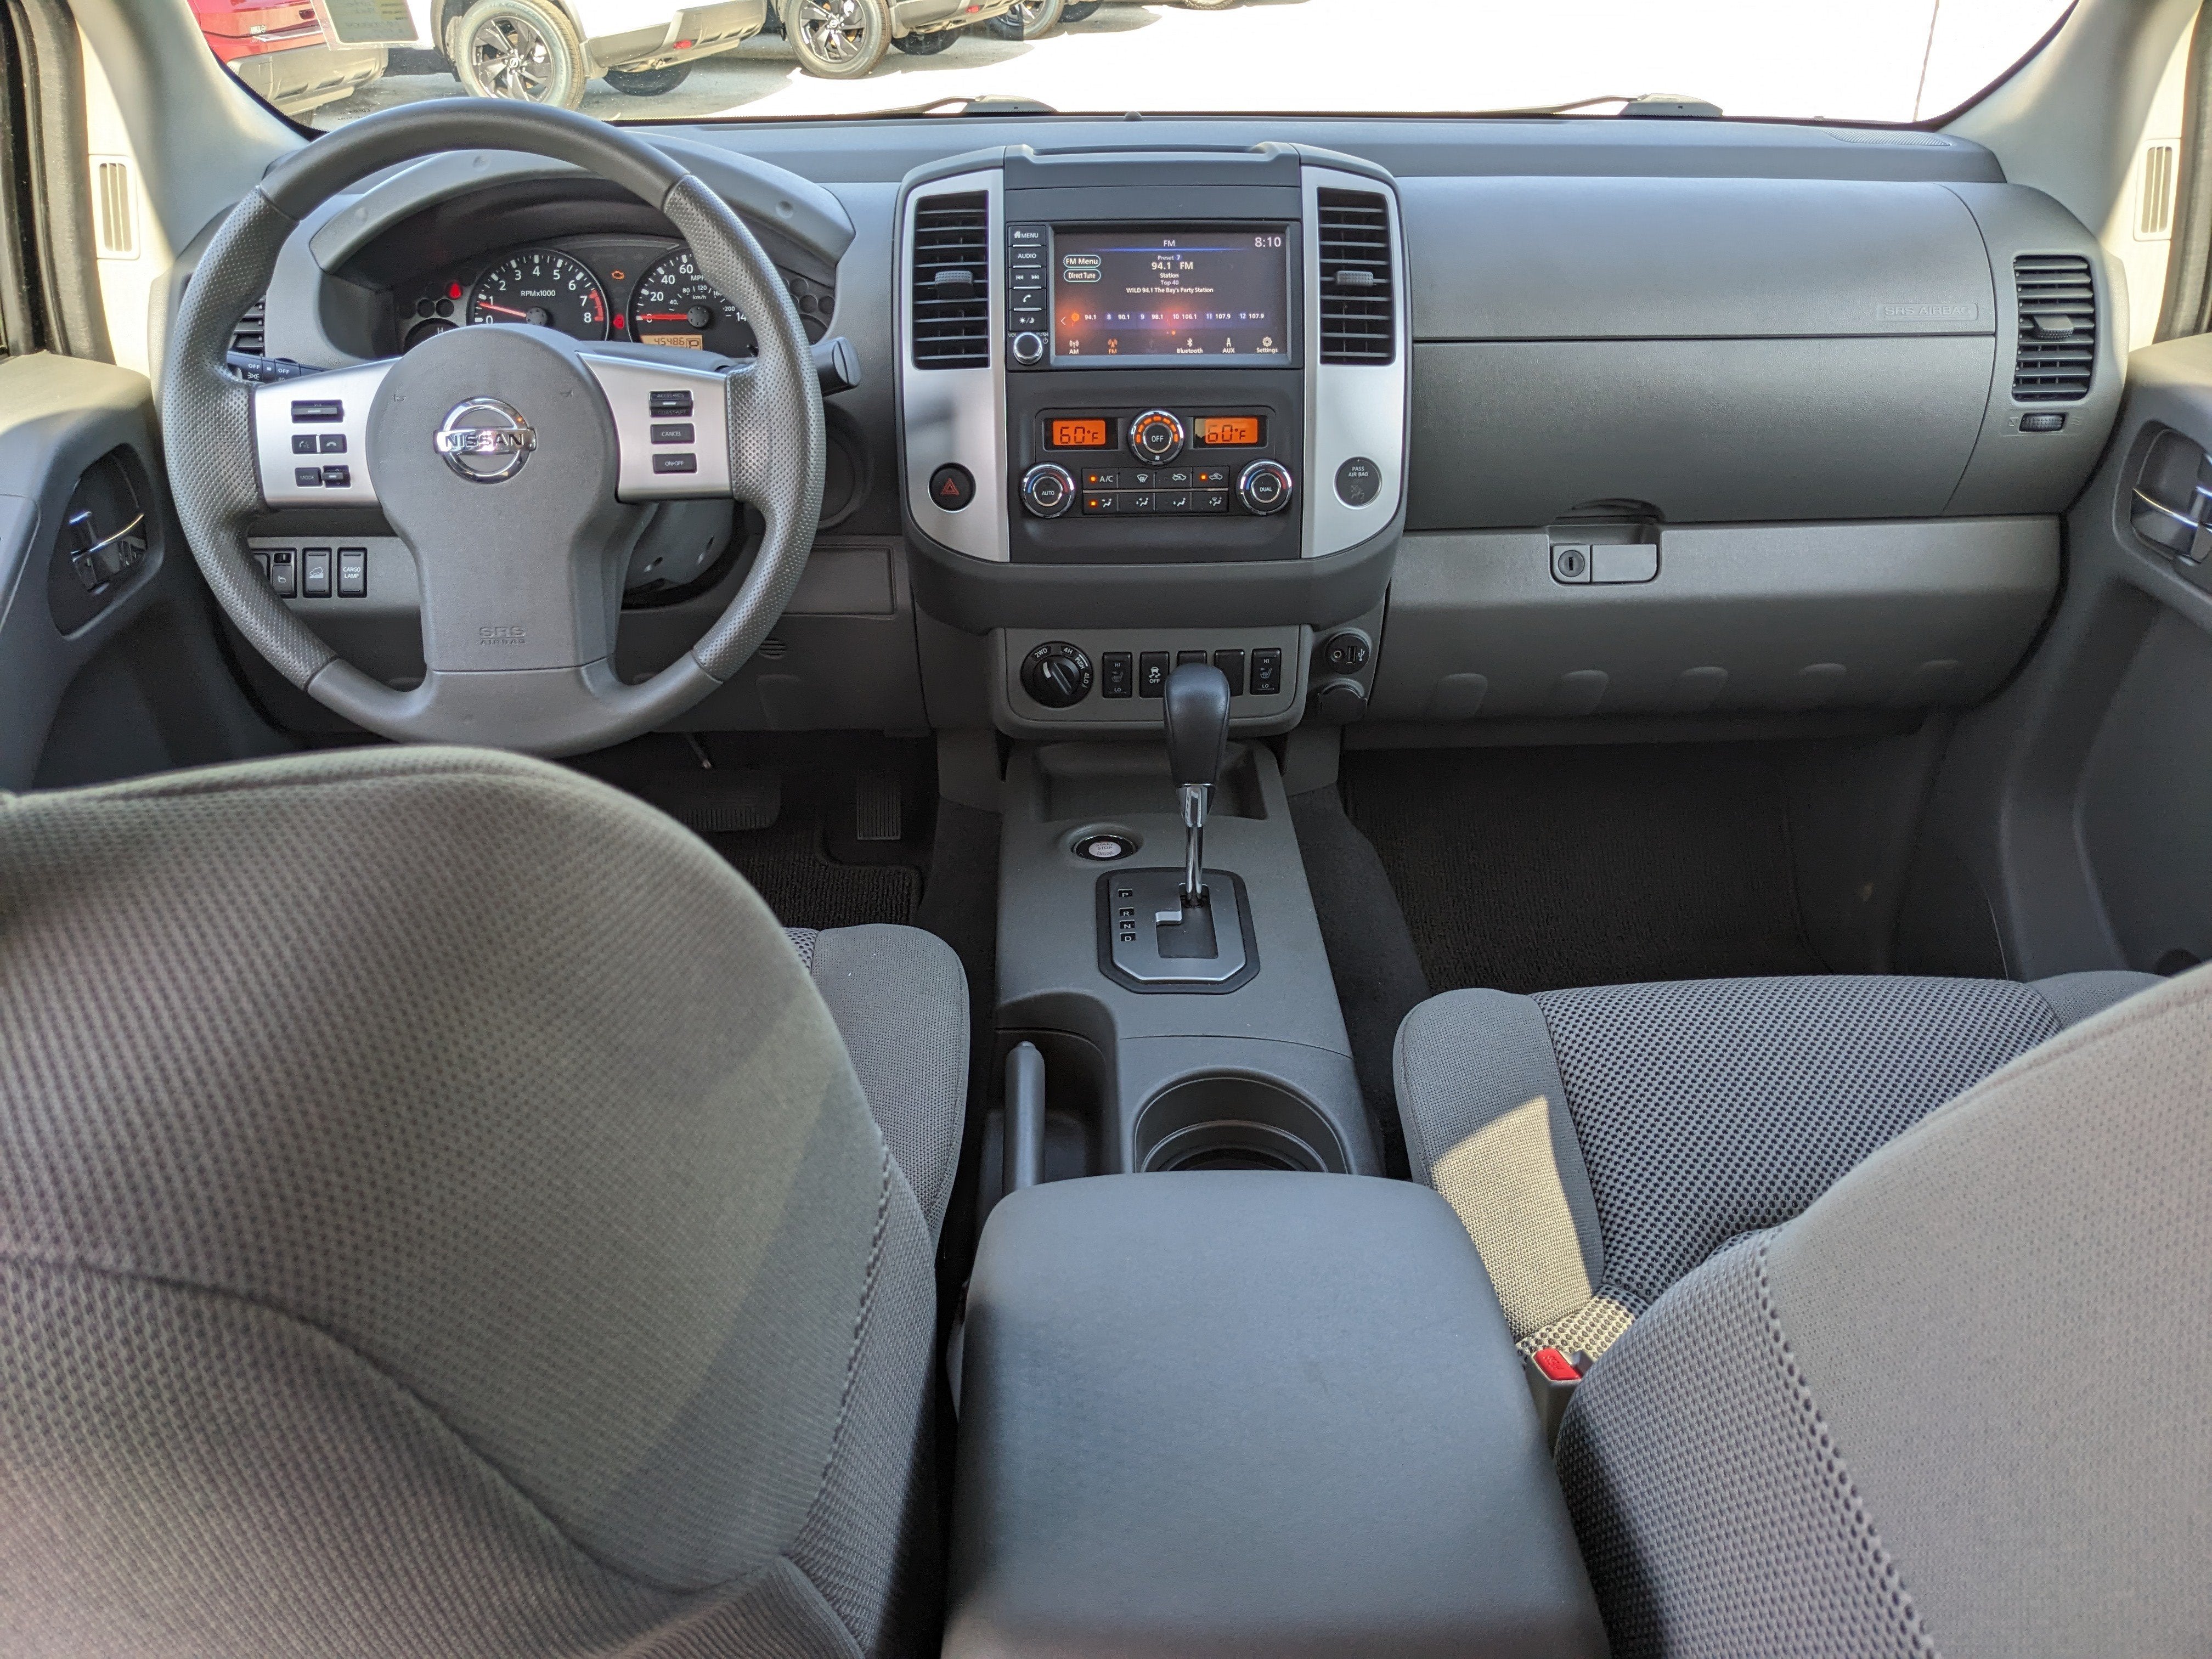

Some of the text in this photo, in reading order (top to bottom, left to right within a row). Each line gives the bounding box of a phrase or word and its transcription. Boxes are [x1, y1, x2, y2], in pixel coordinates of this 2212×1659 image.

[1255, 237, 1281, 247] 8:10
[533, 266, 540, 276] 4
[679, 264, 693, 274] 60
[515, 270, 521, 280] 3
[553, 270, 560, 280] 5
[661, 275, 675, 284] 40
[499, 280, 506, 291] 2
[568, 280, 576, 290] 6
[580, 296, 588, 306] 7
[651, 292, 664, 301] 20
[1884, 306, 1972, 315] SRS AIRBAG
[486, 316, 493, 324] 0
[584, 313, 591, 323] 8
[654, 337, 685, 346] 45486
[445, 433, 524, 448] NISSAN
[479, 627, 526, 637] SRS
[1034, 647, 1048, 658] 2WD
[1075, 657, 1085, 669] PUSH
